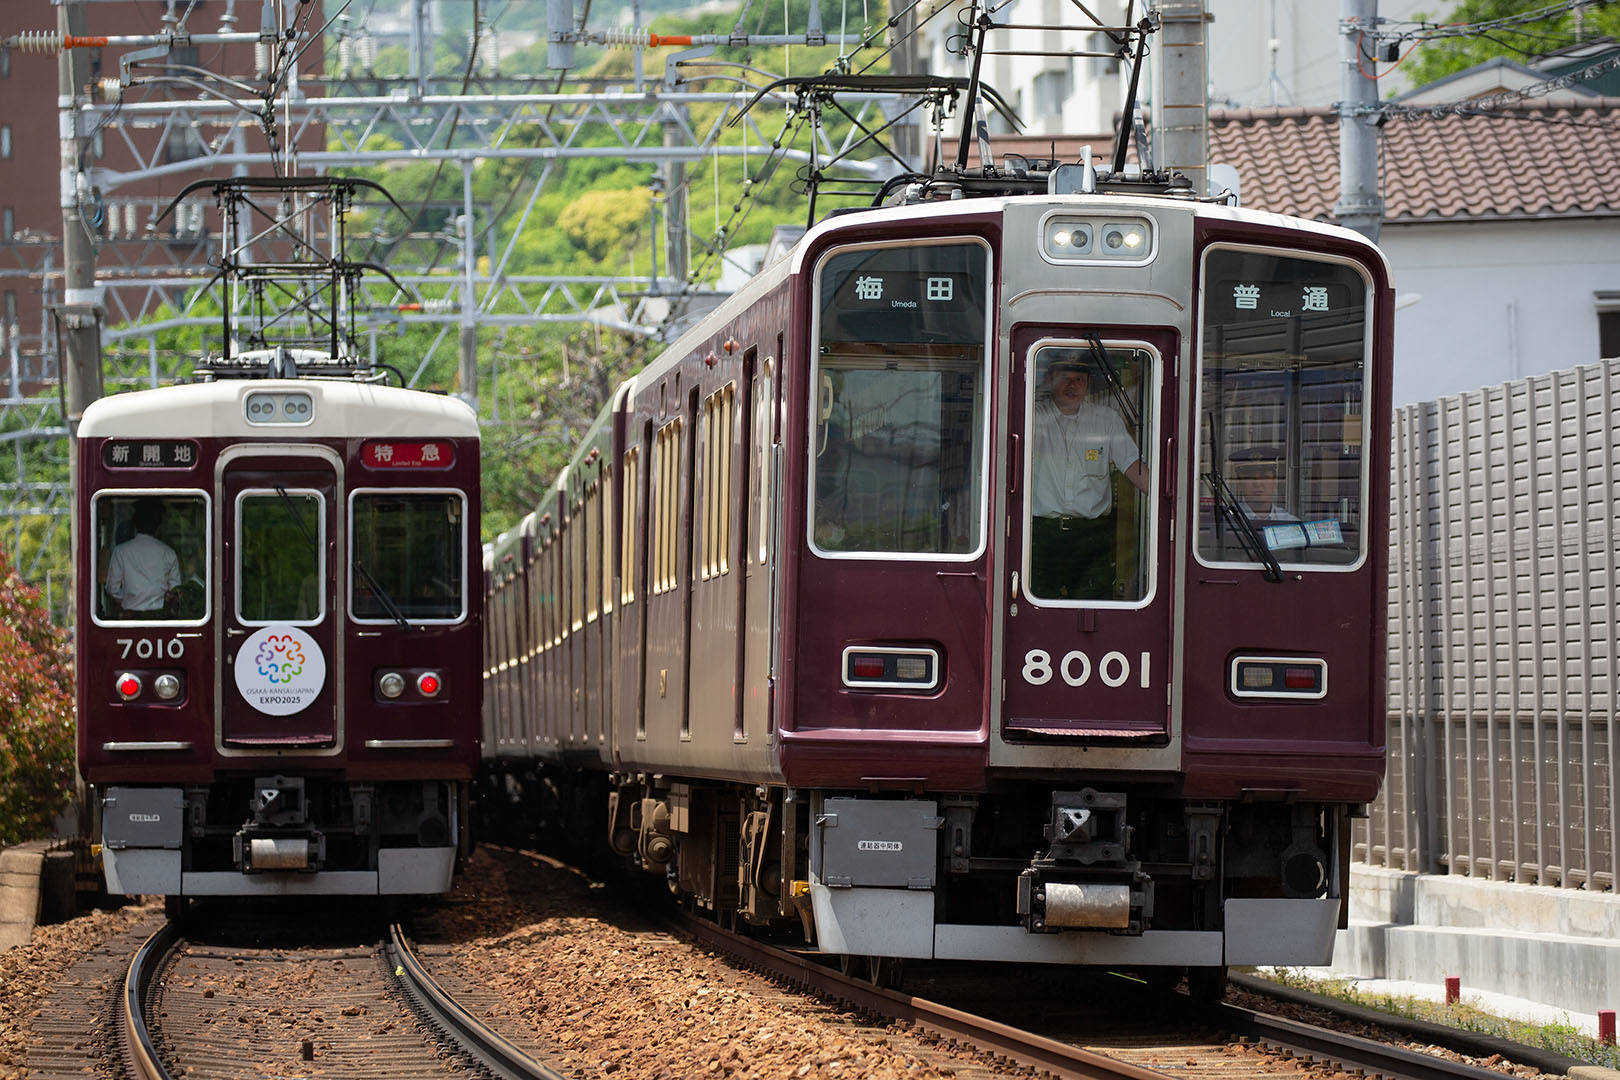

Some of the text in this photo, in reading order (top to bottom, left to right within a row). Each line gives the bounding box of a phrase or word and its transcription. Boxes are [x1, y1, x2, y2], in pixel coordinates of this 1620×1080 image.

[856, 276, 953, 301] 梅田
[1233, 284, 1330, 311] 普通
[891, 300, 917, 308] Umeda
[1270, 310, 1291, 318] Local
[374, 443, 440, 462] 特急
[116, 638, 185, 660] 7010
[1021, 649, 1151, 689] 8001
